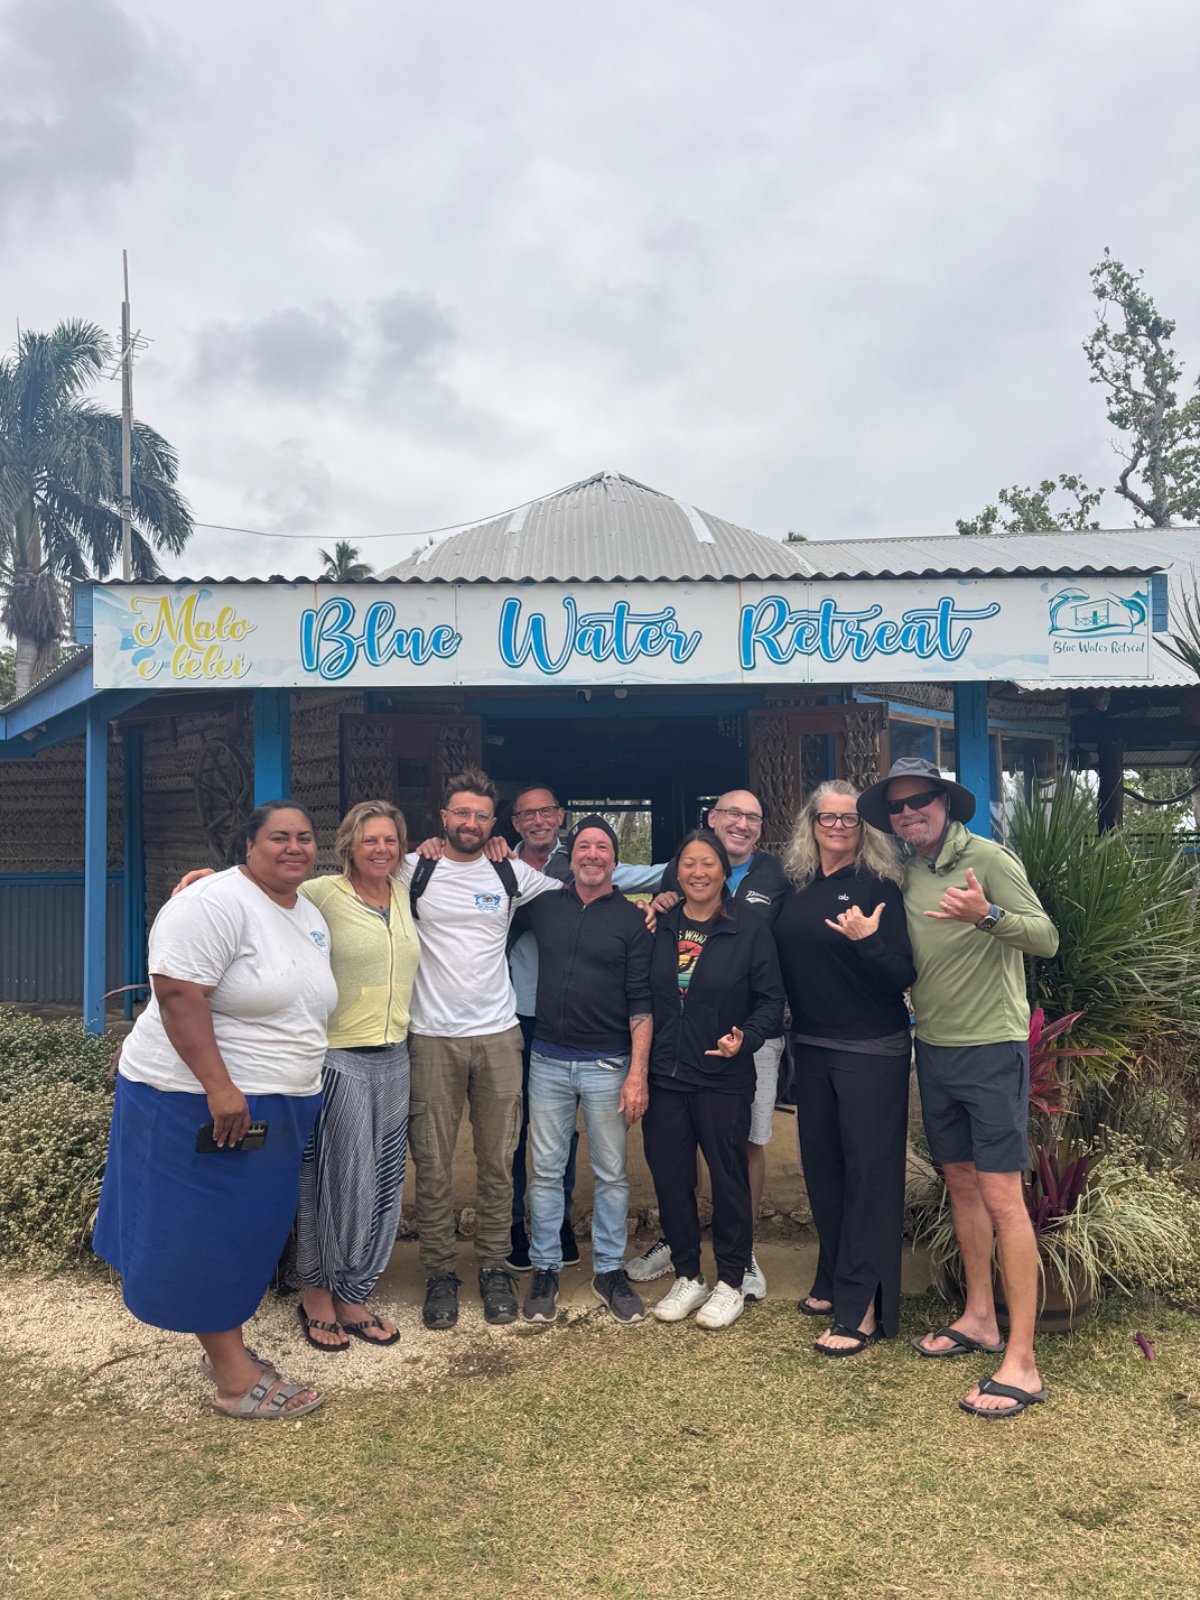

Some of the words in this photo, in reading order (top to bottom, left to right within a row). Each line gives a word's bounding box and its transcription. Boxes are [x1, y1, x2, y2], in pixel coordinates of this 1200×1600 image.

[130, 593, 257, 653] Malo
[300, 597, 462, 680] Blue
[498, 597, 702, 675] Water
[738, 595, 1001, 670] Retreat
[138, 659, 164, 680] e
[171, 643, 252, 680] lelei
[1053, 640, 1076, 654] Blue
[1078, 640, 1108, 654] Water
[1111, 640, 1145, 654] Retreat
[684, 929, 708, 945] WHAT
